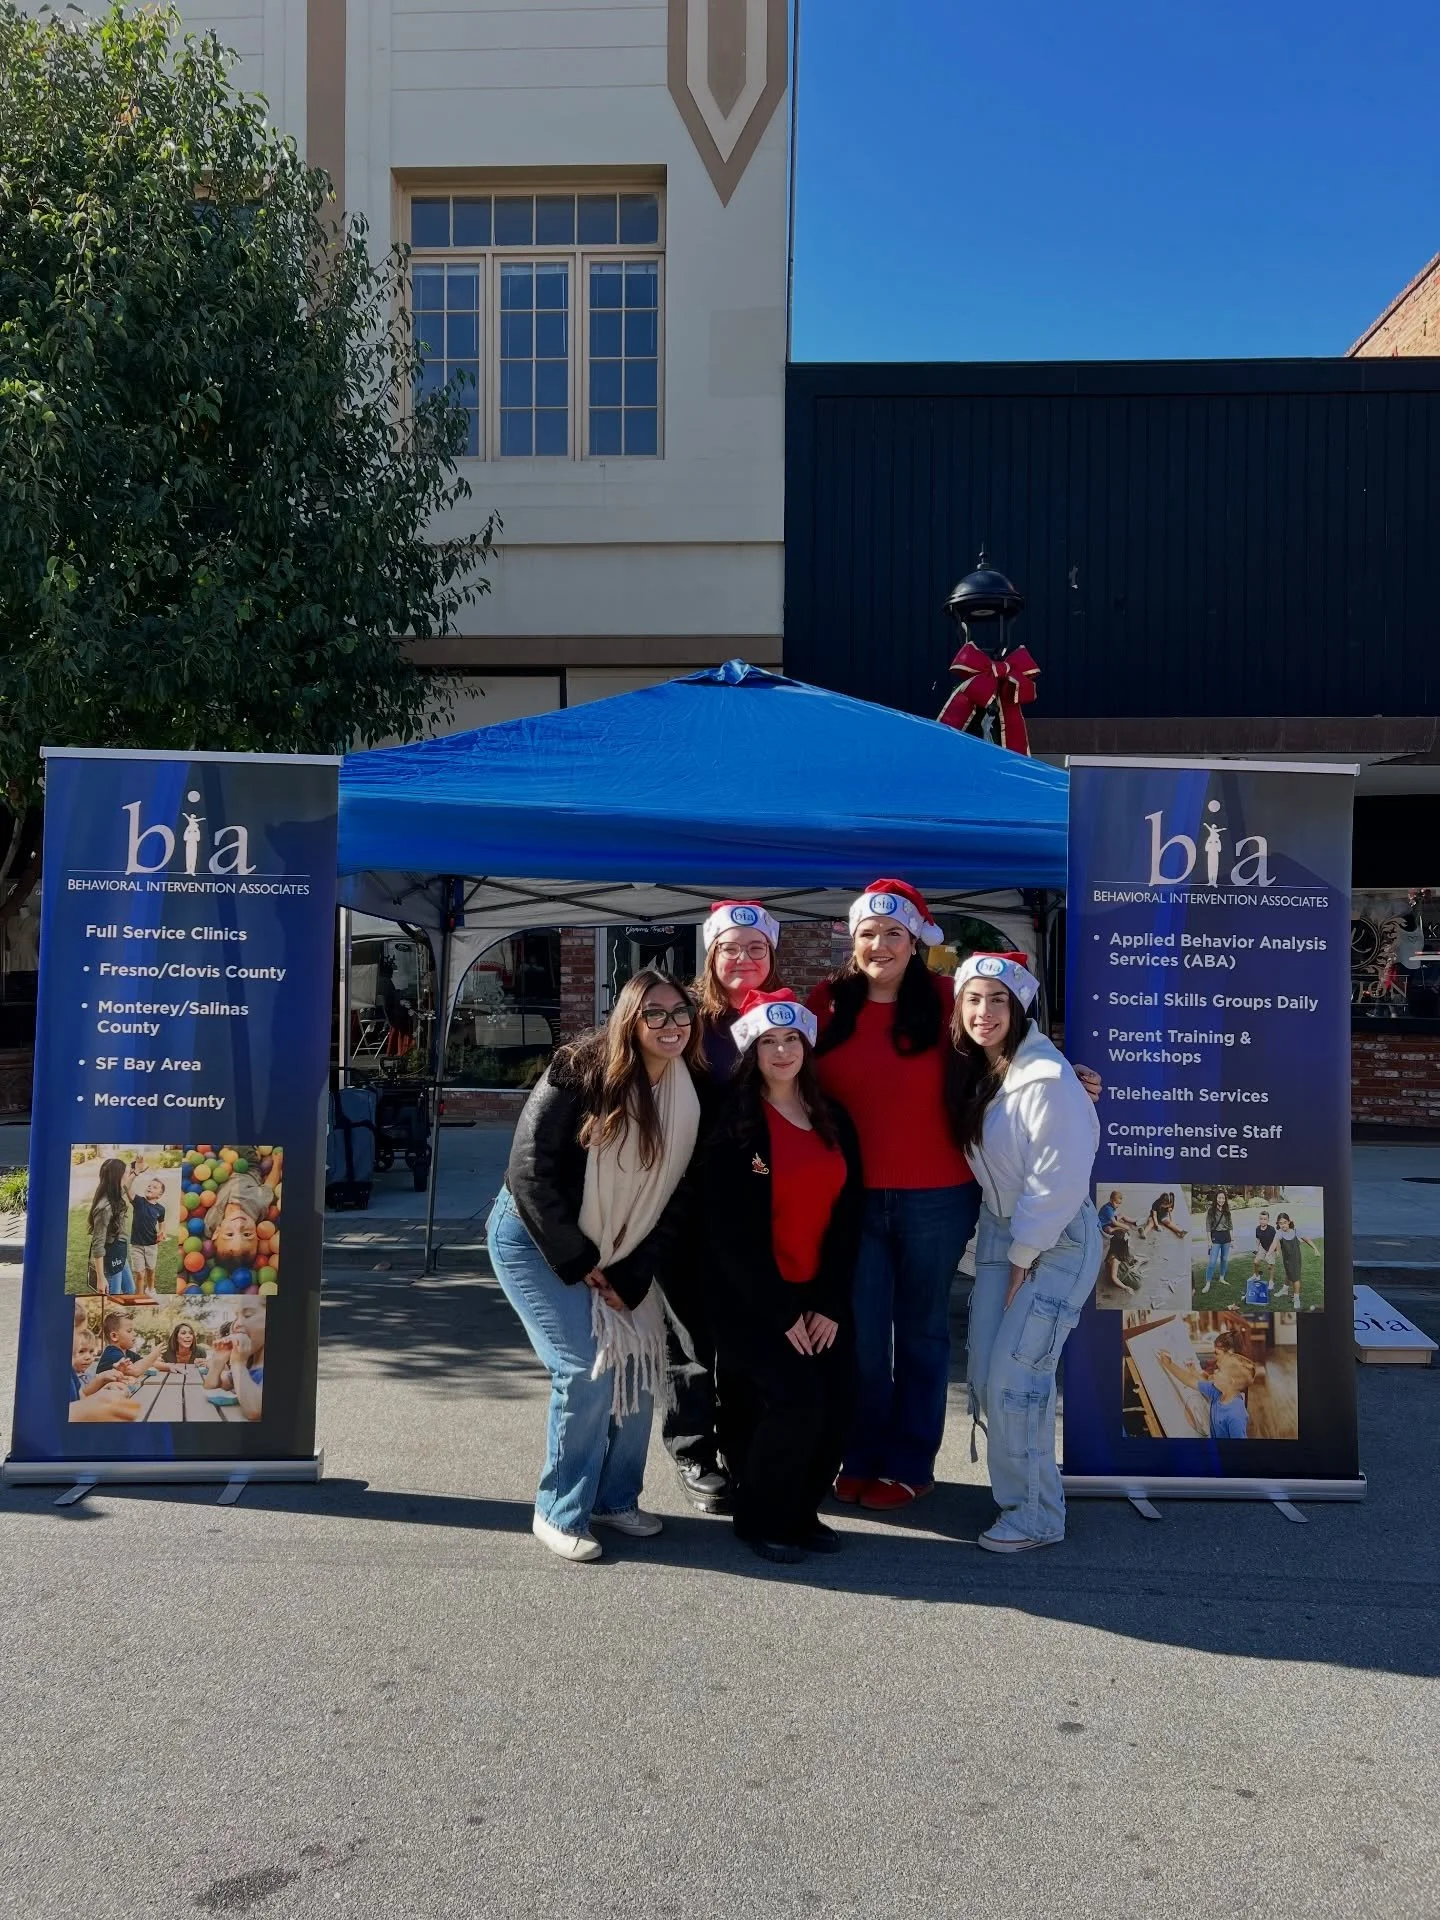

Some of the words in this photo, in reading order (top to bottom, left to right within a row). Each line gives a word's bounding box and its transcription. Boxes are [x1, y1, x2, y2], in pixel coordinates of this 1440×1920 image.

[122, 790, 257, 876] bia
[1145, 800, 1277, 888] bia
[68, 879, 143, 891] BEHAVIORAL
[147, 881, 235, 893] INTERVENTION
[239, 883, 309, 894] ASSOCIATES
[1094, 891, 1166, 903] BEHAVIORAL
[1170, 893, 1257, 905] INTERVENTION
[1260, 895, 1328, 907] ASSOCIATES
[86, 925, 117, 937] Full
[123, 926, 185, 939] Service
[191, 927, 247, 940] Clinics
[1110, 933, 1174, 948] Applied
[1181, 934, 1254, 948] Behavior
[1260, 936, 1326, 952] Analysis
[1110, 952, 1178, 966] Services
[1184, 954, 1235, 969] (ABA)
[100, 963, 220, 978] Fresno/Clovis
[226, 966, 286, 981] County
[99, 1001, 248, 1016] Monterey/Salinas
[1109, 992, 1157, 1005] Social
[1164, 993, 1207, 1006] Skills
[1213, 994, 1271, 1010] Groups
[1278, 996, 1318, 1011] Daily
[98, 1020, 160, 1036] County
[1109, 1029, 1162, 1042] Parent
[1168, 1030, 1234, 1046] Training
[1240, 1032, 1251, 1044] &
[96, 1057, 118, 1069] SF
[124, 1058, 156, 1072] Bay
[160, 1058, 201, 1071] Area
[1109, 1049, 1201, 1065] Workshops
[95, 1094, 158, 1106] Merced
[164, 1094, 225, 1109] County
[1108, 1087, 1193, 1101] Telehealth
[1200, 1089, 1268, 1102] Services
[1108, 1123, 1237, 1138] Comprehensive
[1243, 1125, 1282, 1138] Staff
[1108, 1143, 1174, 1159] Training
[1180, 1144, 1210, 1157] and
[1217, 1145, 1248, 1158] CEs
